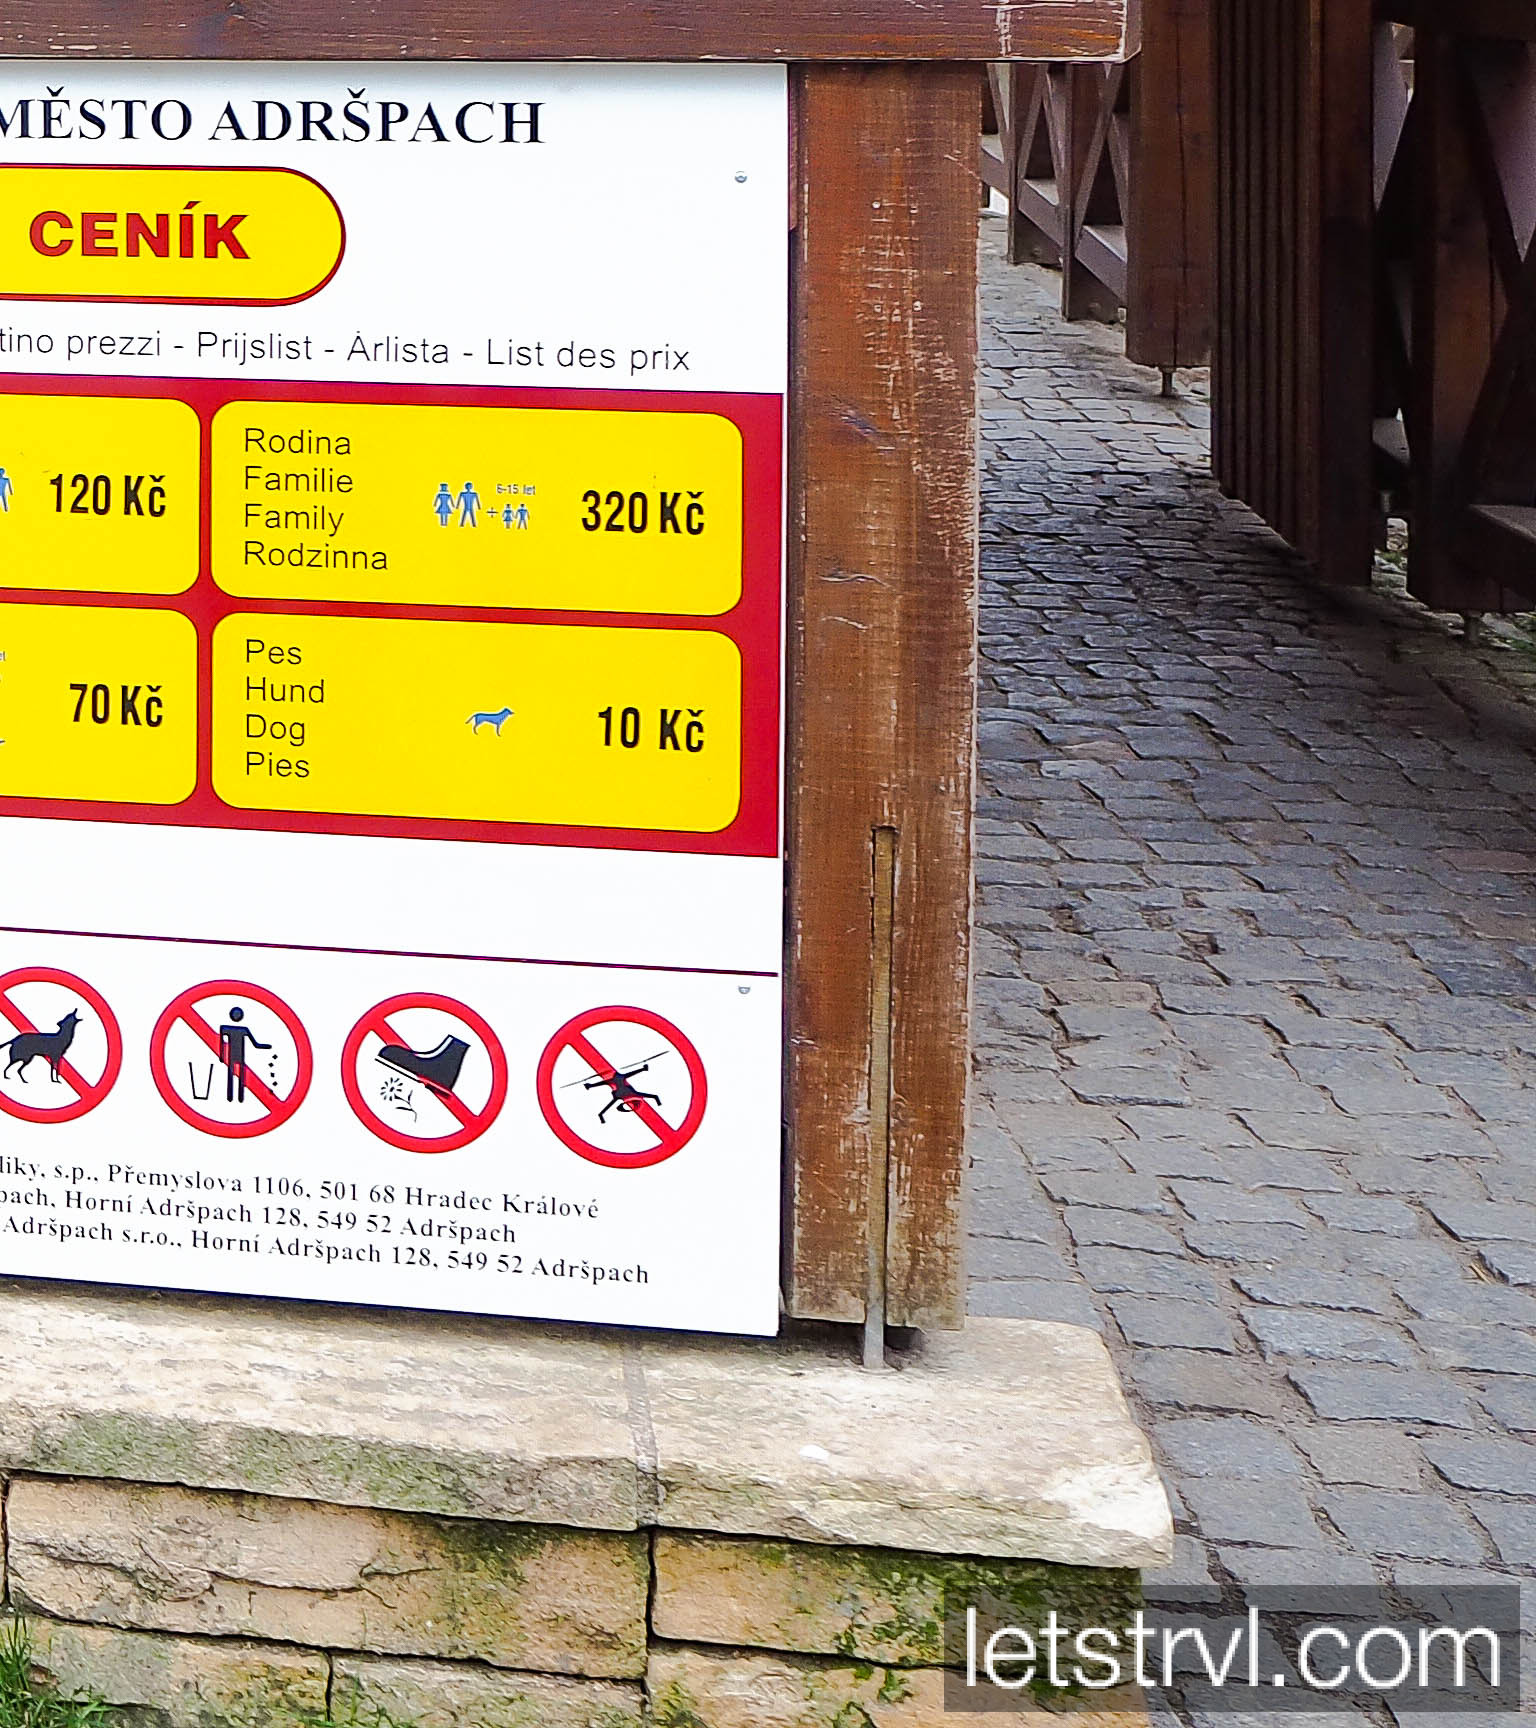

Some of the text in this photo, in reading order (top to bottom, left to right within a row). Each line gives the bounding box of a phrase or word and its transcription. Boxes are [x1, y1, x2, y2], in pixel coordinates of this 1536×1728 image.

[207, 87, 545, 144] ADRŠPACH
[29, 200, 251, 260] CENÍK
[67, 330, 161, 361] prezzi
[198, 331, 313, 366] Prijslist
[487, 338, 545, 367] List
[556, 340, 616, 369] des
[630, 343, 690, 377] prix
[245, 427, 351, 456] Rodina
[49, 473, 166, 518] 120 Kč
[245, 465, 353, 494] Familie
[244, 503, 345, 538] Family
[581, 489, 705, 536] 320 Kč
[244, 540, 388, 570] Rodzinna
[246, 638, 302, 665] Pes
[69, 682, 163, 728] 70 Kč
[246, 675, 325, 704] Hund
[246, 713, 305, 747] Dog
[597, 706, 705, 753] 10 Kč
[246, 751, 310, 778] Pies
[107, 1163, 243, 1193] Přemyslova
[319, 1180, 358, 1201] 501
[369, 1184, 395, 1204] 68
[404, 1186, 493, 1211] Hradec
[501, 1193, 599, 1219] Králové
[64, 1189, 133, 1214] Horní
[139, 1196, 253, 1225] Adršpach
[316, 1210, 357, 1231] 549
[365, 1214, 392, 1234] 52
[399, 1217, 516, 1246] Adršpach
[2, 1215, 113, 1243] Adršpach
[191, 1229, 260, 1254] Horní
[267, 1236, 381, 1265] Adršpach
[447, 1250, 488, 1271] 549
[496, 1254, 524, 1274] 52
[530, 1257, 649, 1286] Adršpach
